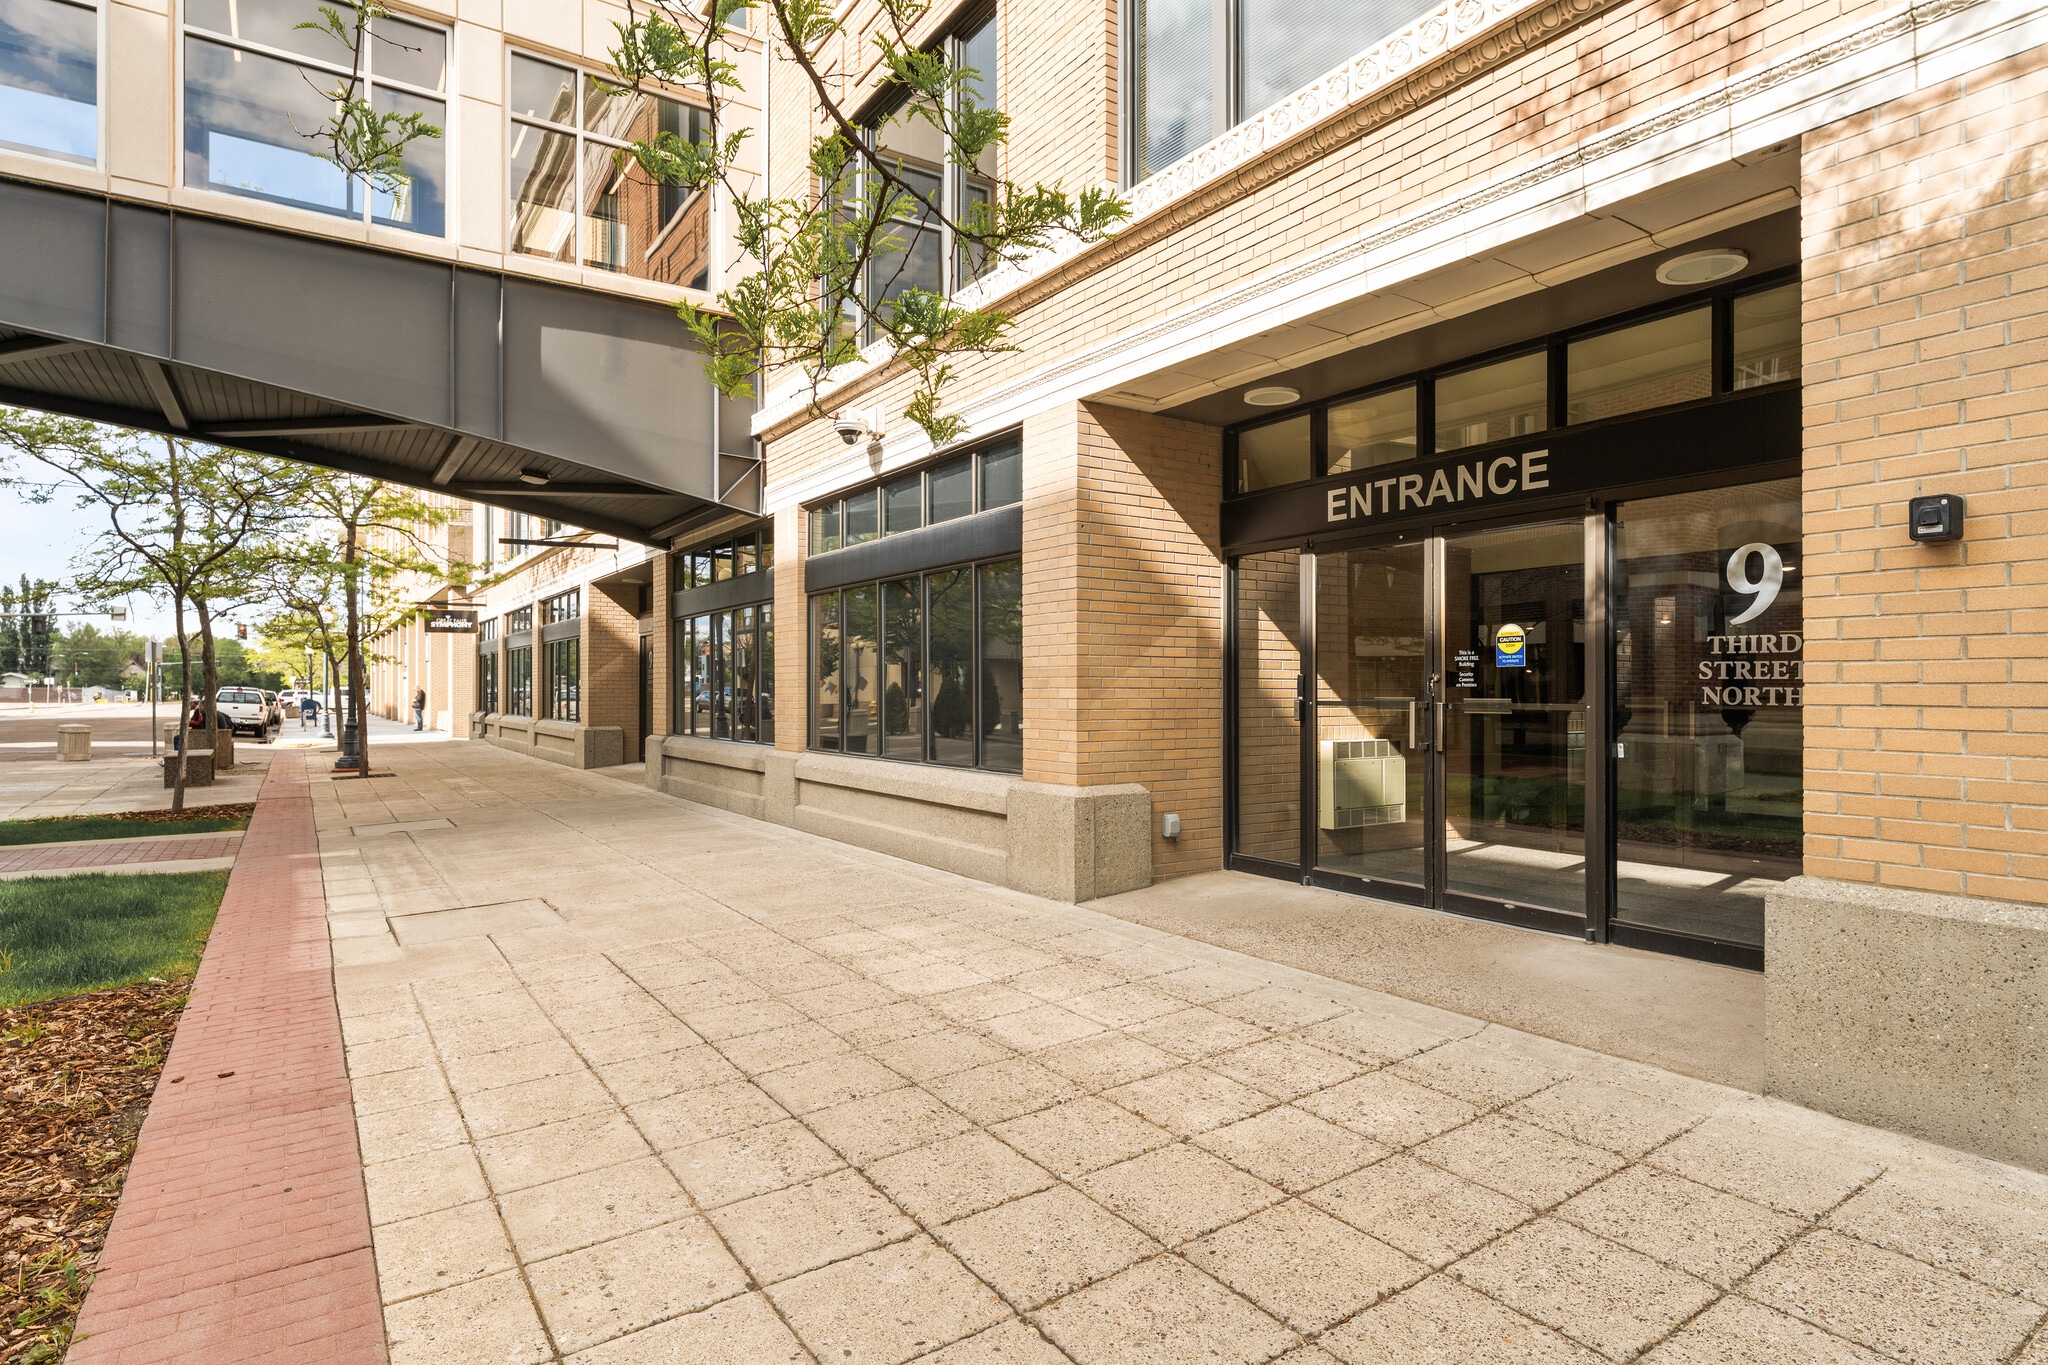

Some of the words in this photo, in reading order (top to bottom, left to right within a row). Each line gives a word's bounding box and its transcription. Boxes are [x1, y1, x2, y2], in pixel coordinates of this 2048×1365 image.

[1327, 449, 1549, 523] ENTRANCE
[1726, 542, 1784, 626] 9
[1706, 634, 1803, 655] THIRD
[1699, 660, 1804, 680] STREET
[1701, 686, 1804, 707] NORTH
